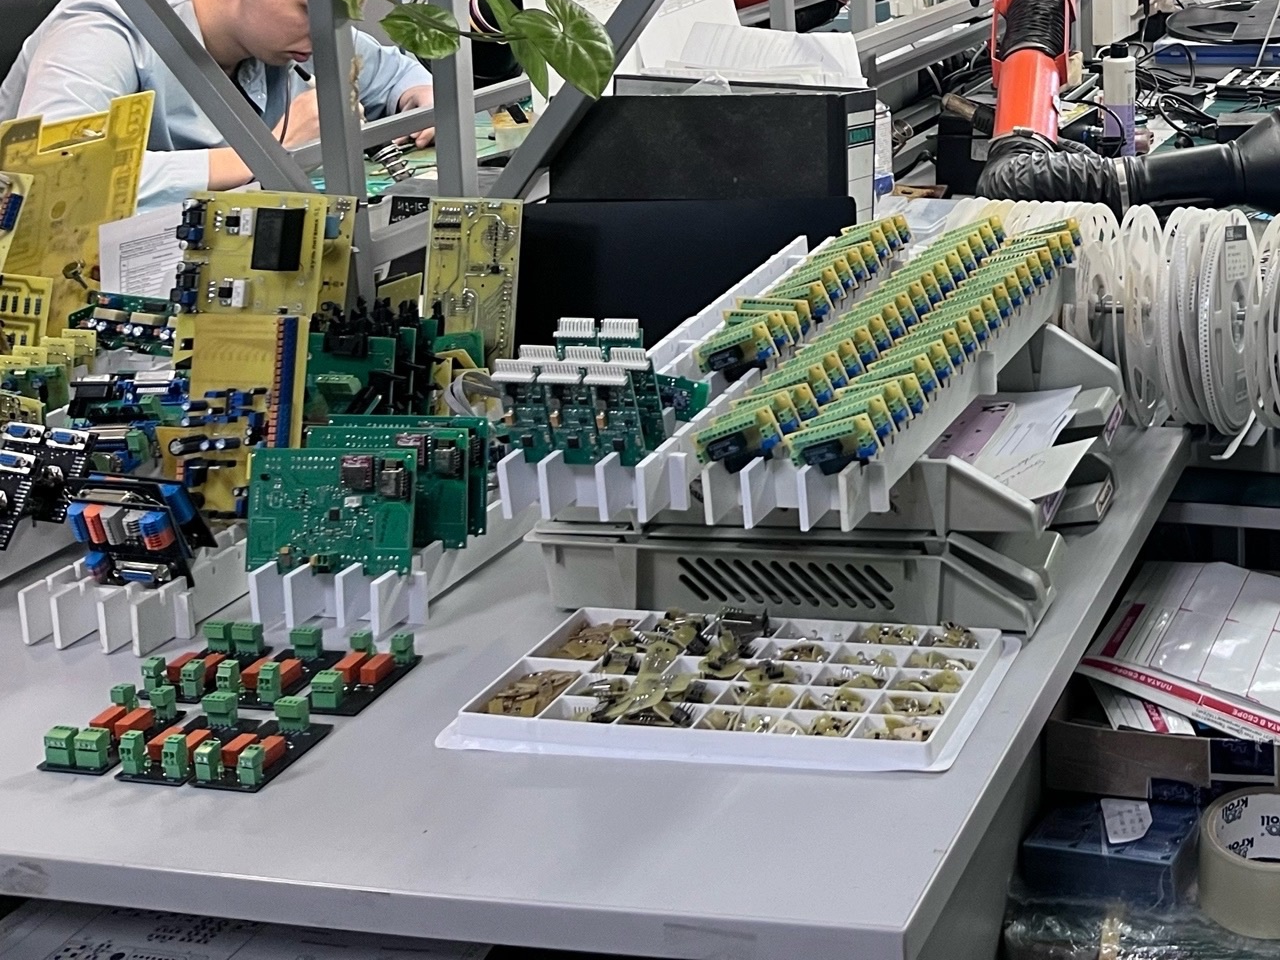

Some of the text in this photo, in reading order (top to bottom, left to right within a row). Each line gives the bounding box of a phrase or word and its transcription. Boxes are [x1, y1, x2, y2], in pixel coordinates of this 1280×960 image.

[1111, 665, 1173, 691] ПЛАТА В СБОРЕ
[1231, 707, 1258, 725] СБОРЕ
[1257, 717, 1265, 727] В
[1222, 797, 1249, 820] kroll
[1226, 837, 1255, 851] kro
